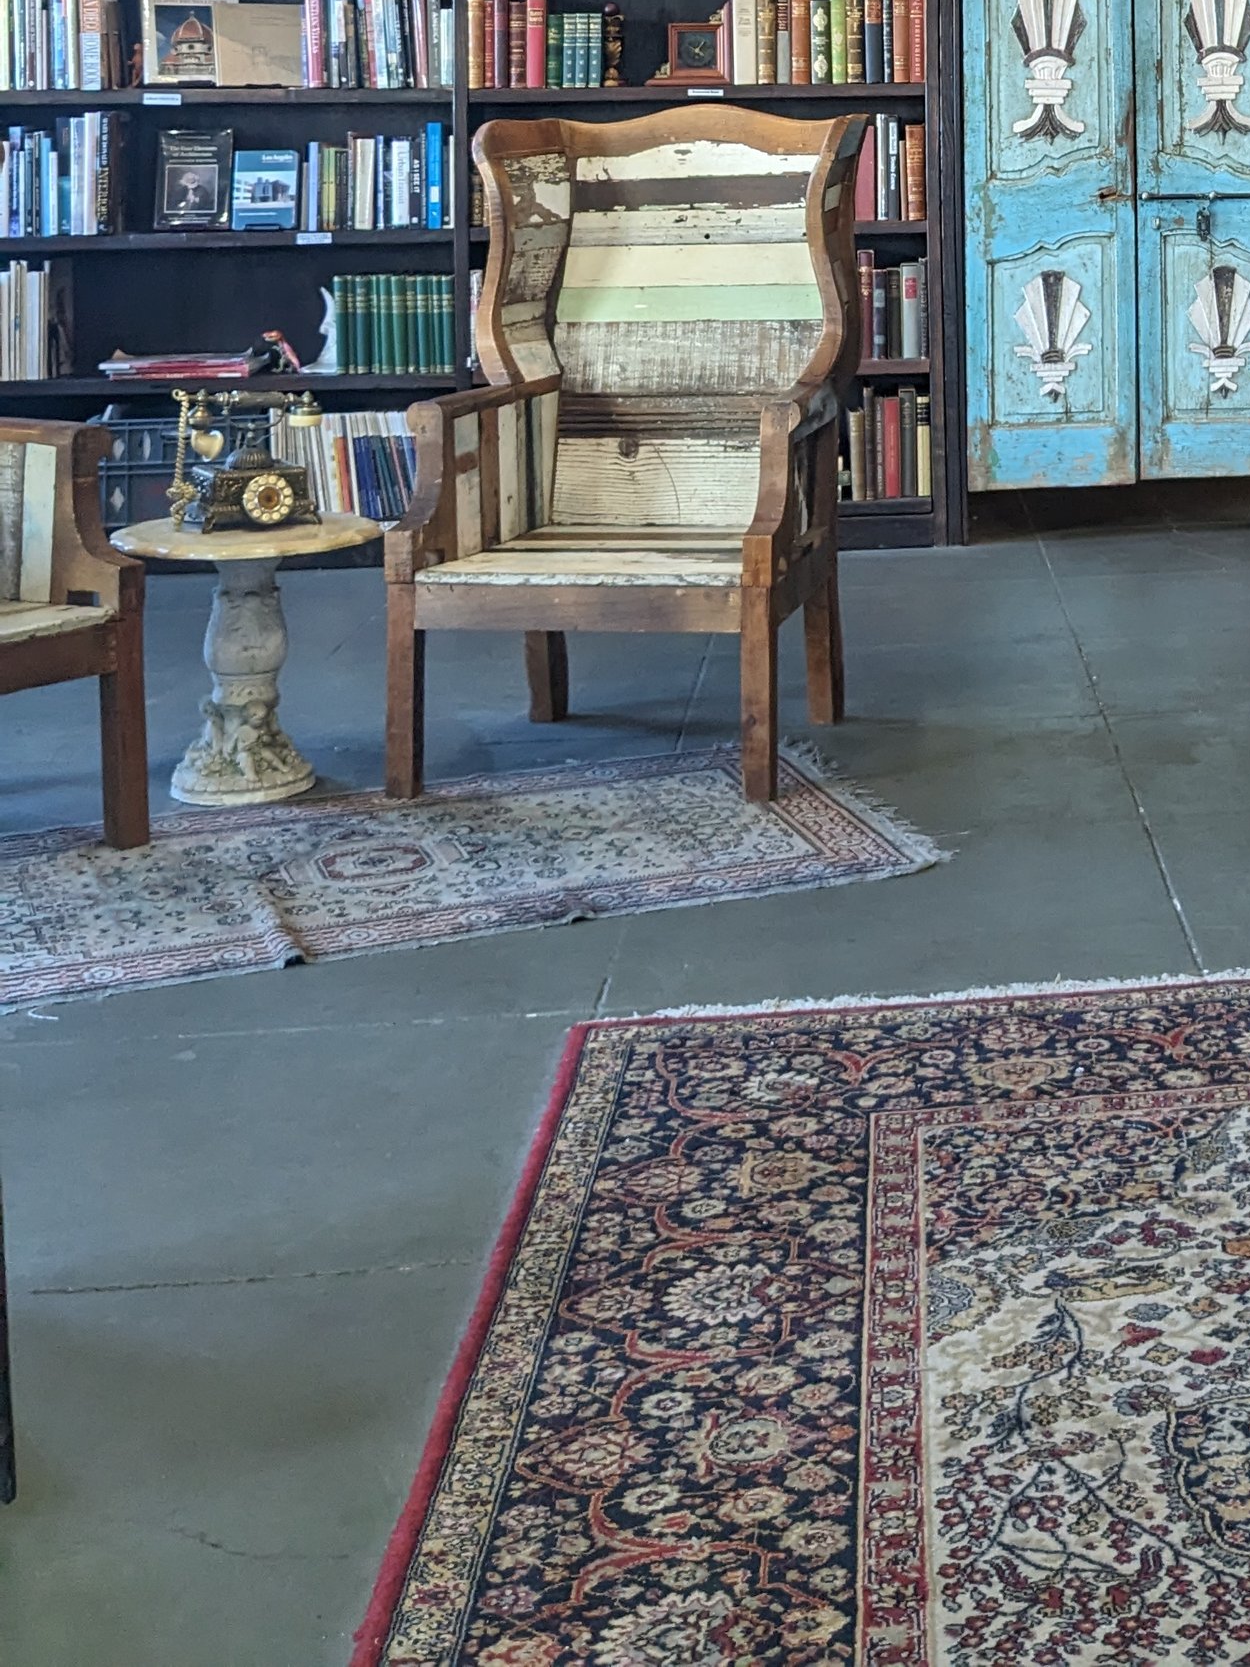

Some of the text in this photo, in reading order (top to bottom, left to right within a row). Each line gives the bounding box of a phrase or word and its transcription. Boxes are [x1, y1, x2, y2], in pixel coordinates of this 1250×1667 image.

[83, 8, 100, 32] DIEGO
[311, 27, 322, 54] VILLAS
[84, 34, 100, 86] HOME BOOK
[398, 151, 406, 177] Urban
[413, 158, 420, 168] AS
[97, 166, 109, 221] INTERIORS
